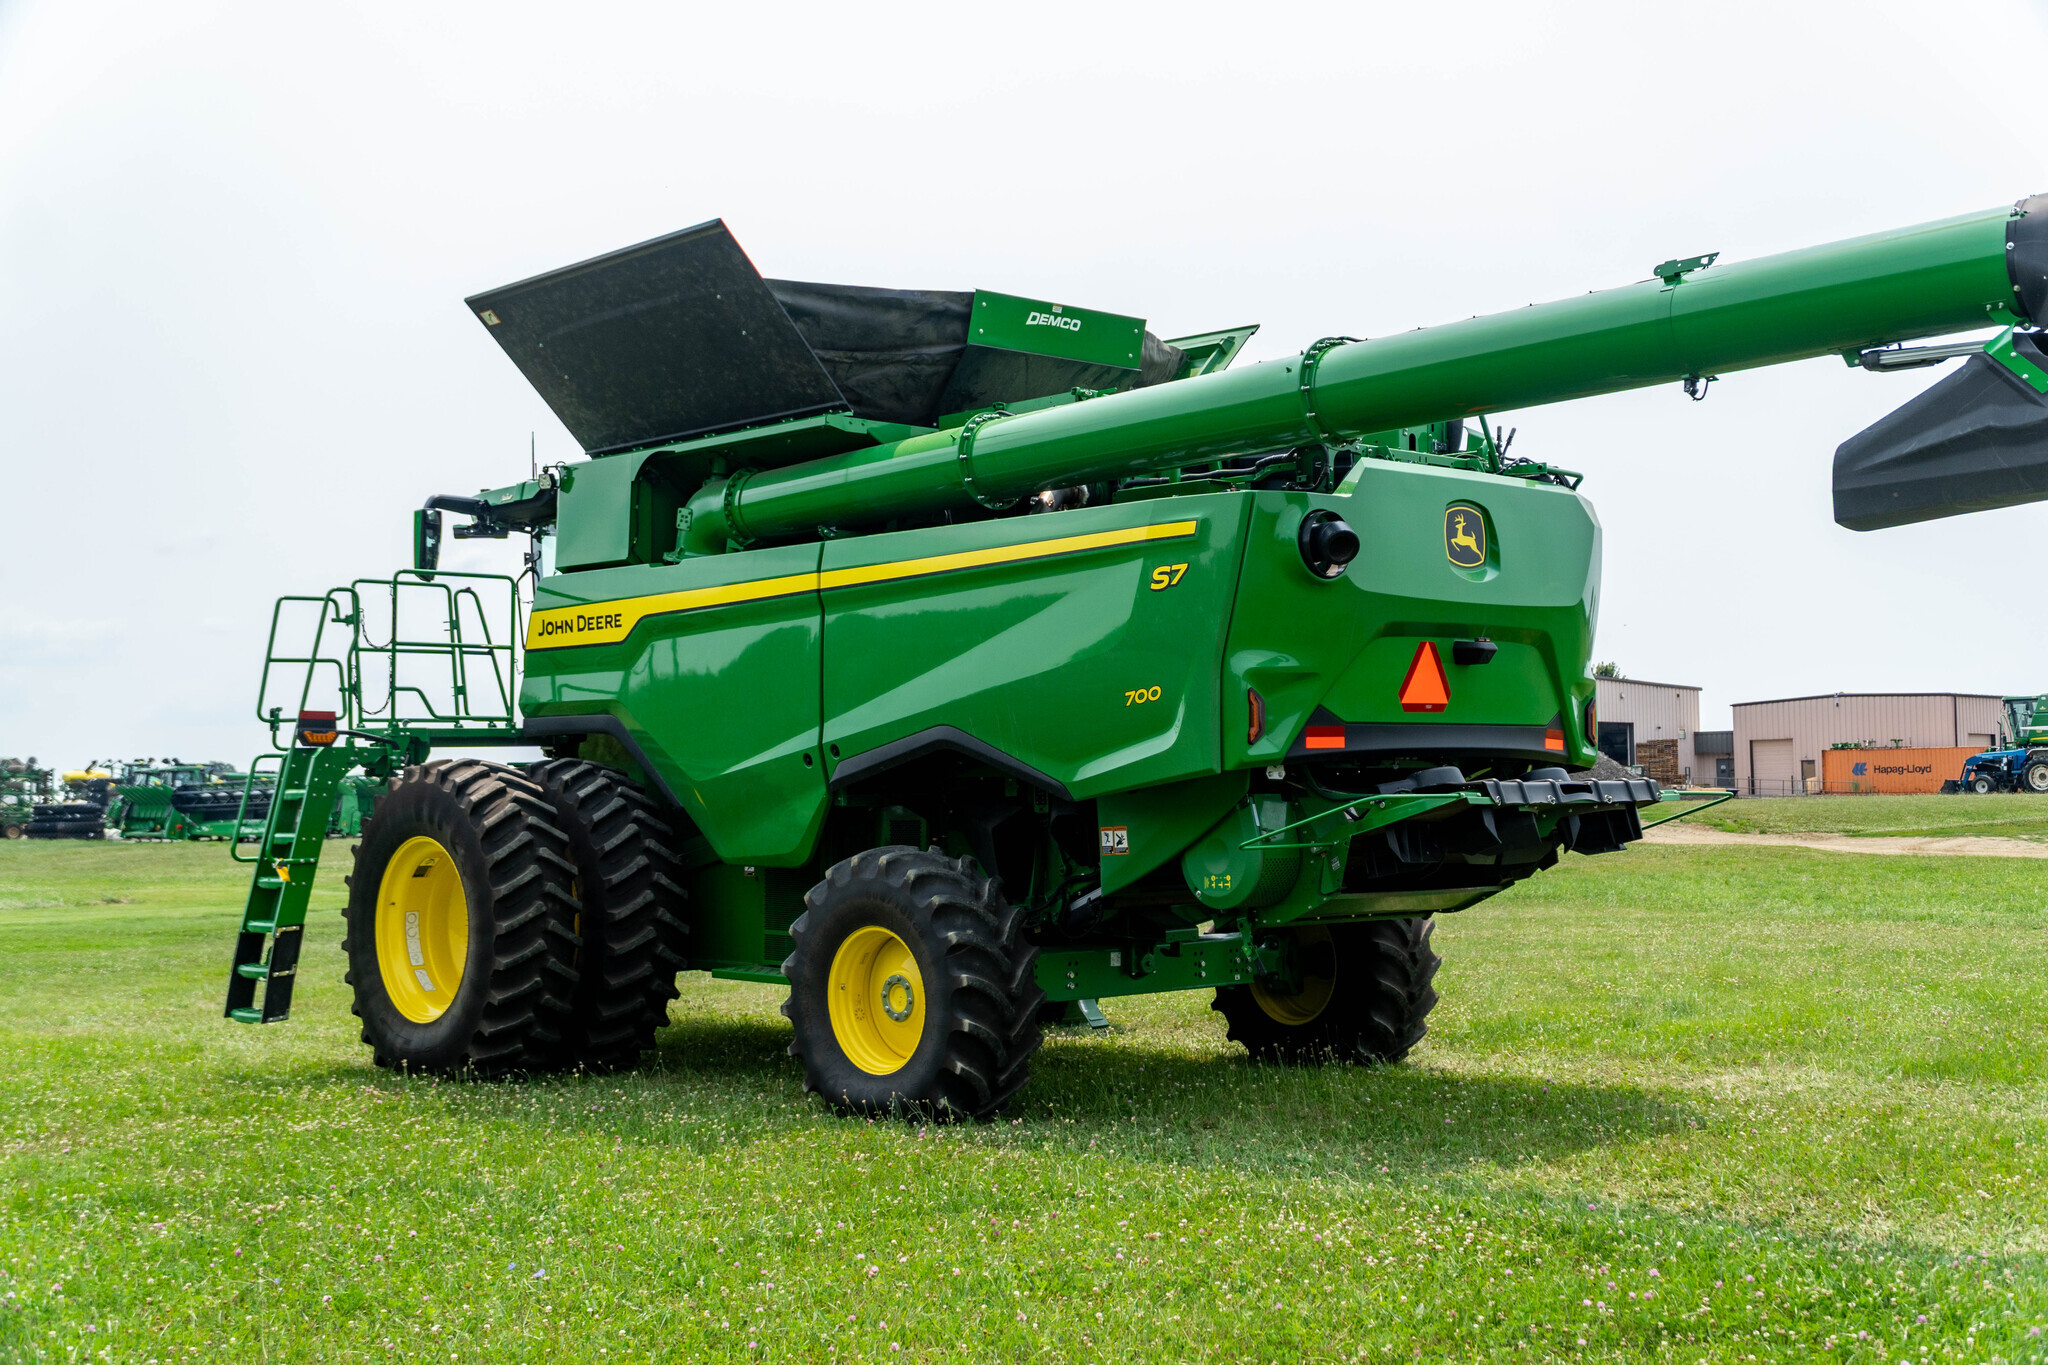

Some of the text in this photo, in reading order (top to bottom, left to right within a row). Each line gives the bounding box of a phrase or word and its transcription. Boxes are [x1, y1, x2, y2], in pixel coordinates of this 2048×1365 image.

[1026, 311, 1081, 331] DEMCO
[1150, 562, 1189, 591] S7
[538, 613, 622, 636] JOHN DEERE
[1124, 685, 1162, 707] 700
[1873, 764, 1932, 775] Hapag-Lloyd
